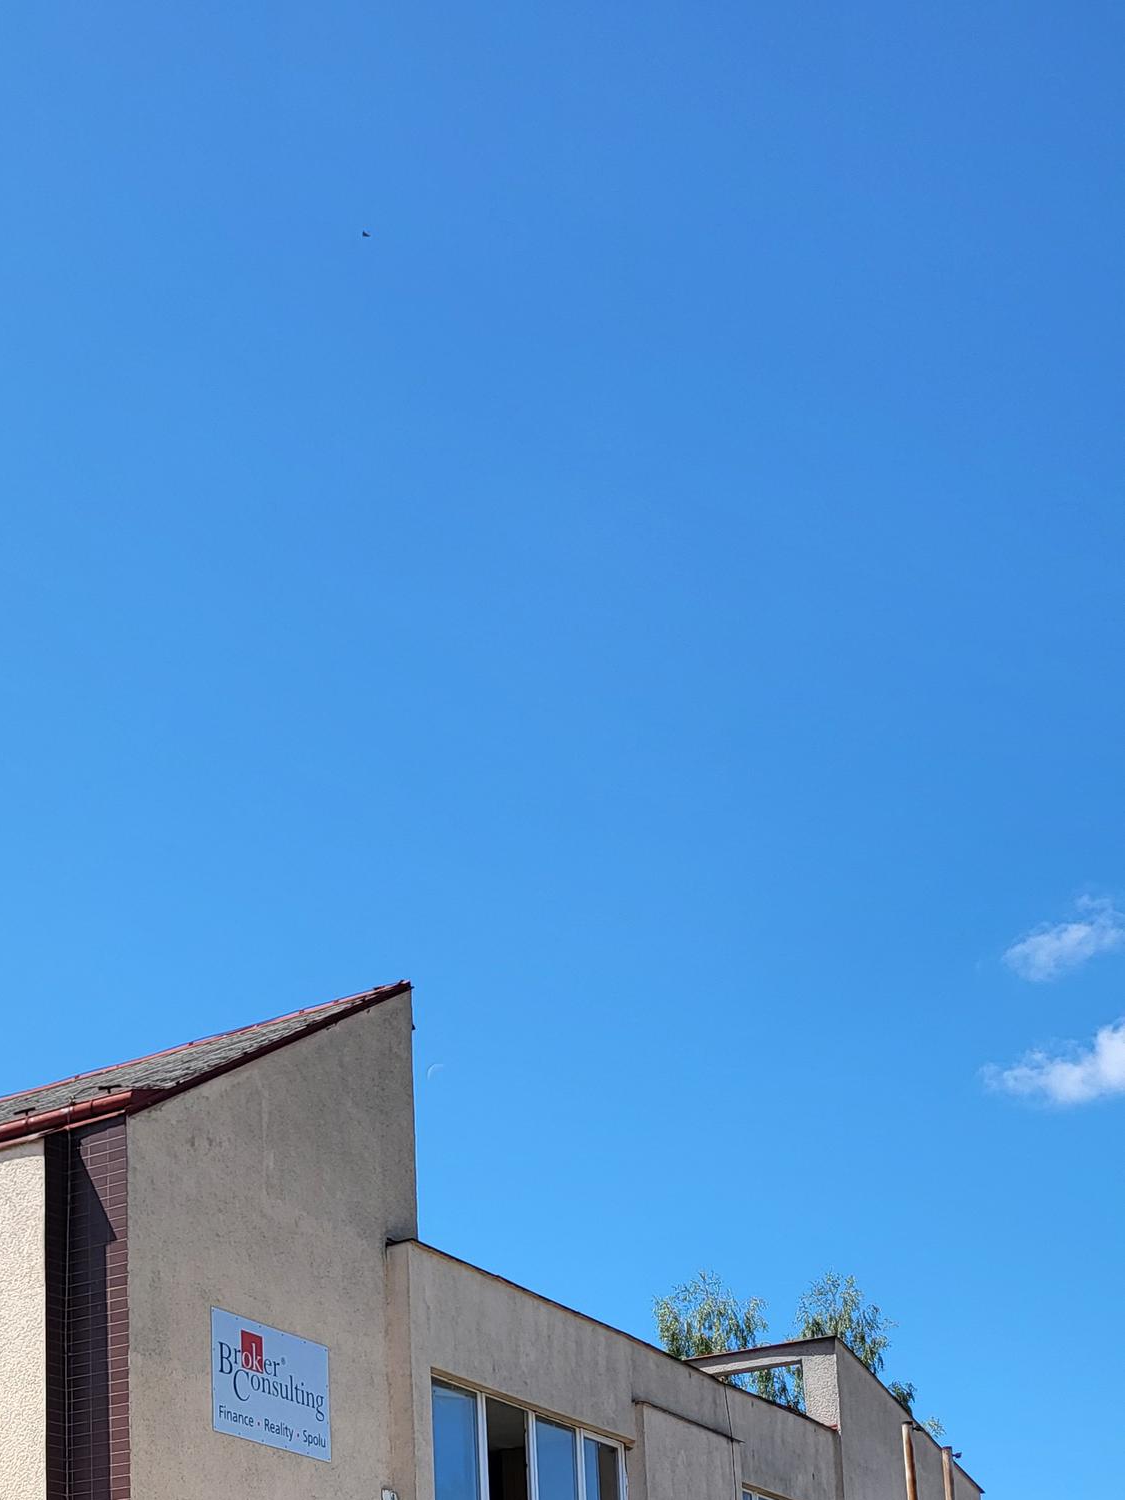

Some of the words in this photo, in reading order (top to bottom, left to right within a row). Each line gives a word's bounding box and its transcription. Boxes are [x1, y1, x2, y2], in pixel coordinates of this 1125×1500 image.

[218, 1341, 280, 1376] Broker
[233, 1369, 325, 1422] Consulting
[218, 1404, 254, 1428] Finance
[264, 1418, 294, 1442] Reality
[302, 1429, 326, 1448] Spolu
